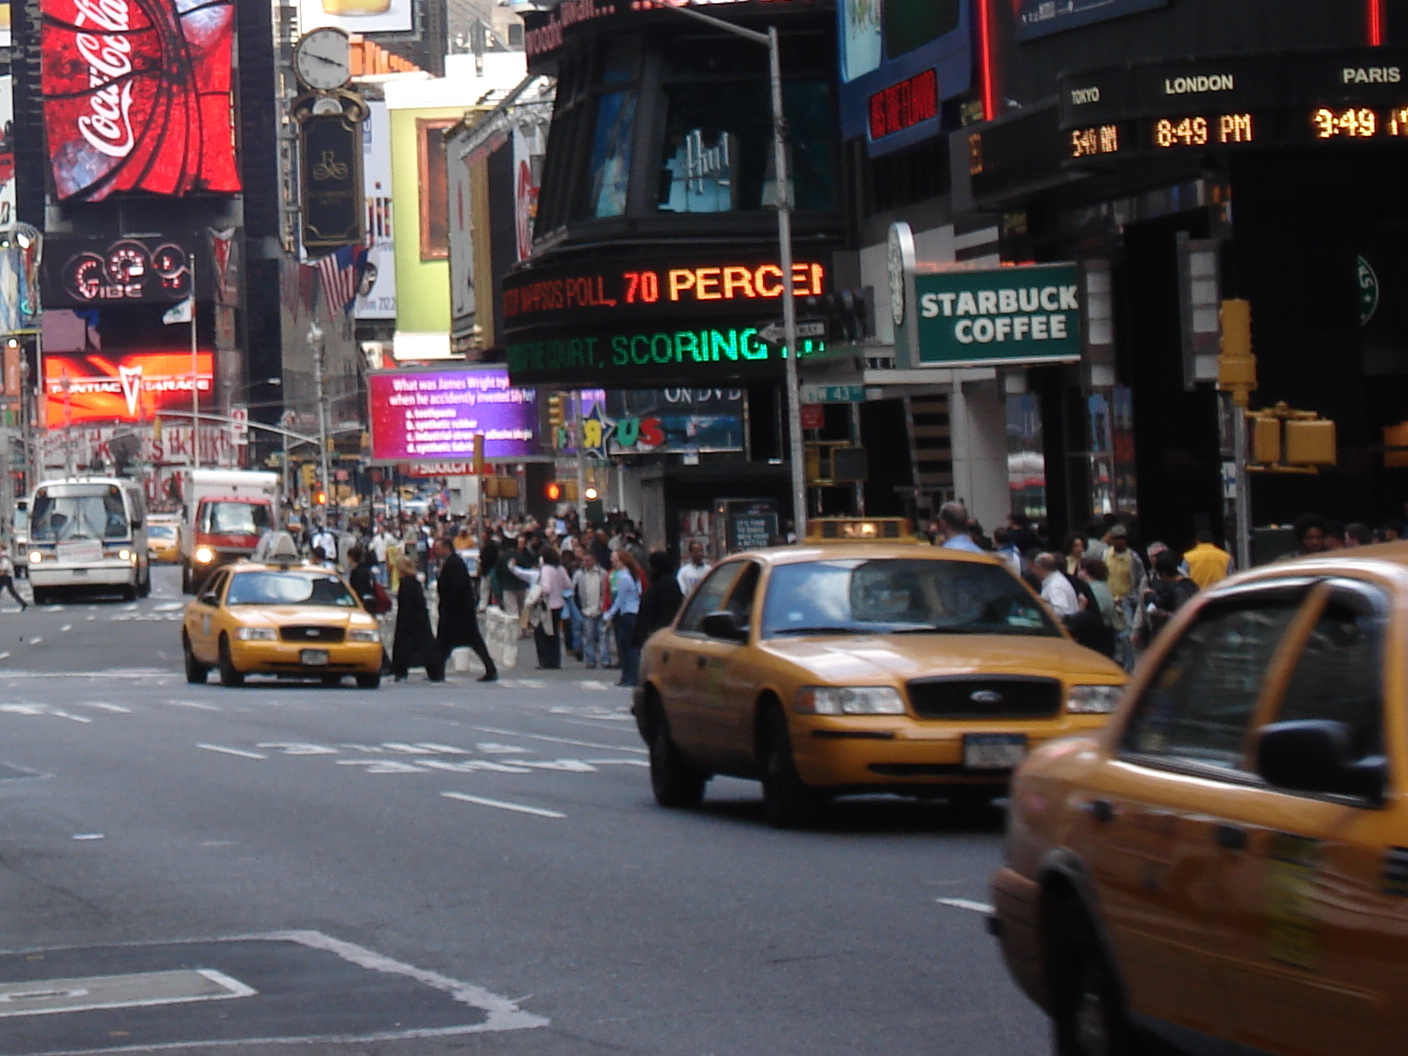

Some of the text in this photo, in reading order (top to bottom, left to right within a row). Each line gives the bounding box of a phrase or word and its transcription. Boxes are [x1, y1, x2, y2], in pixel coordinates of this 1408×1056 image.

[1165, 74, 1234, 94] LONDON
[1343, 67, 1401, 84] PARIS
[1071, 86, 1100, 105] TOKYO
[1219, 111, 1252, 144] PM
[566, 276, 618, 309] POLL,
[623, 271, 659, 304] 70
[954, 314, 1068, 344] COFFEE
[611, 328, 768, 365] SCORING
[393, 378, 418, 392] What
[419, 380, 437, 391] was
[438, 378, 466, 390] James
[467, 376, 495, 391] Wright
[389, 392, 415, 406] when
[416, 391, 429, 405] he
[617, 417, 666, 447] US
[452, 441, 474, 453] fabri
